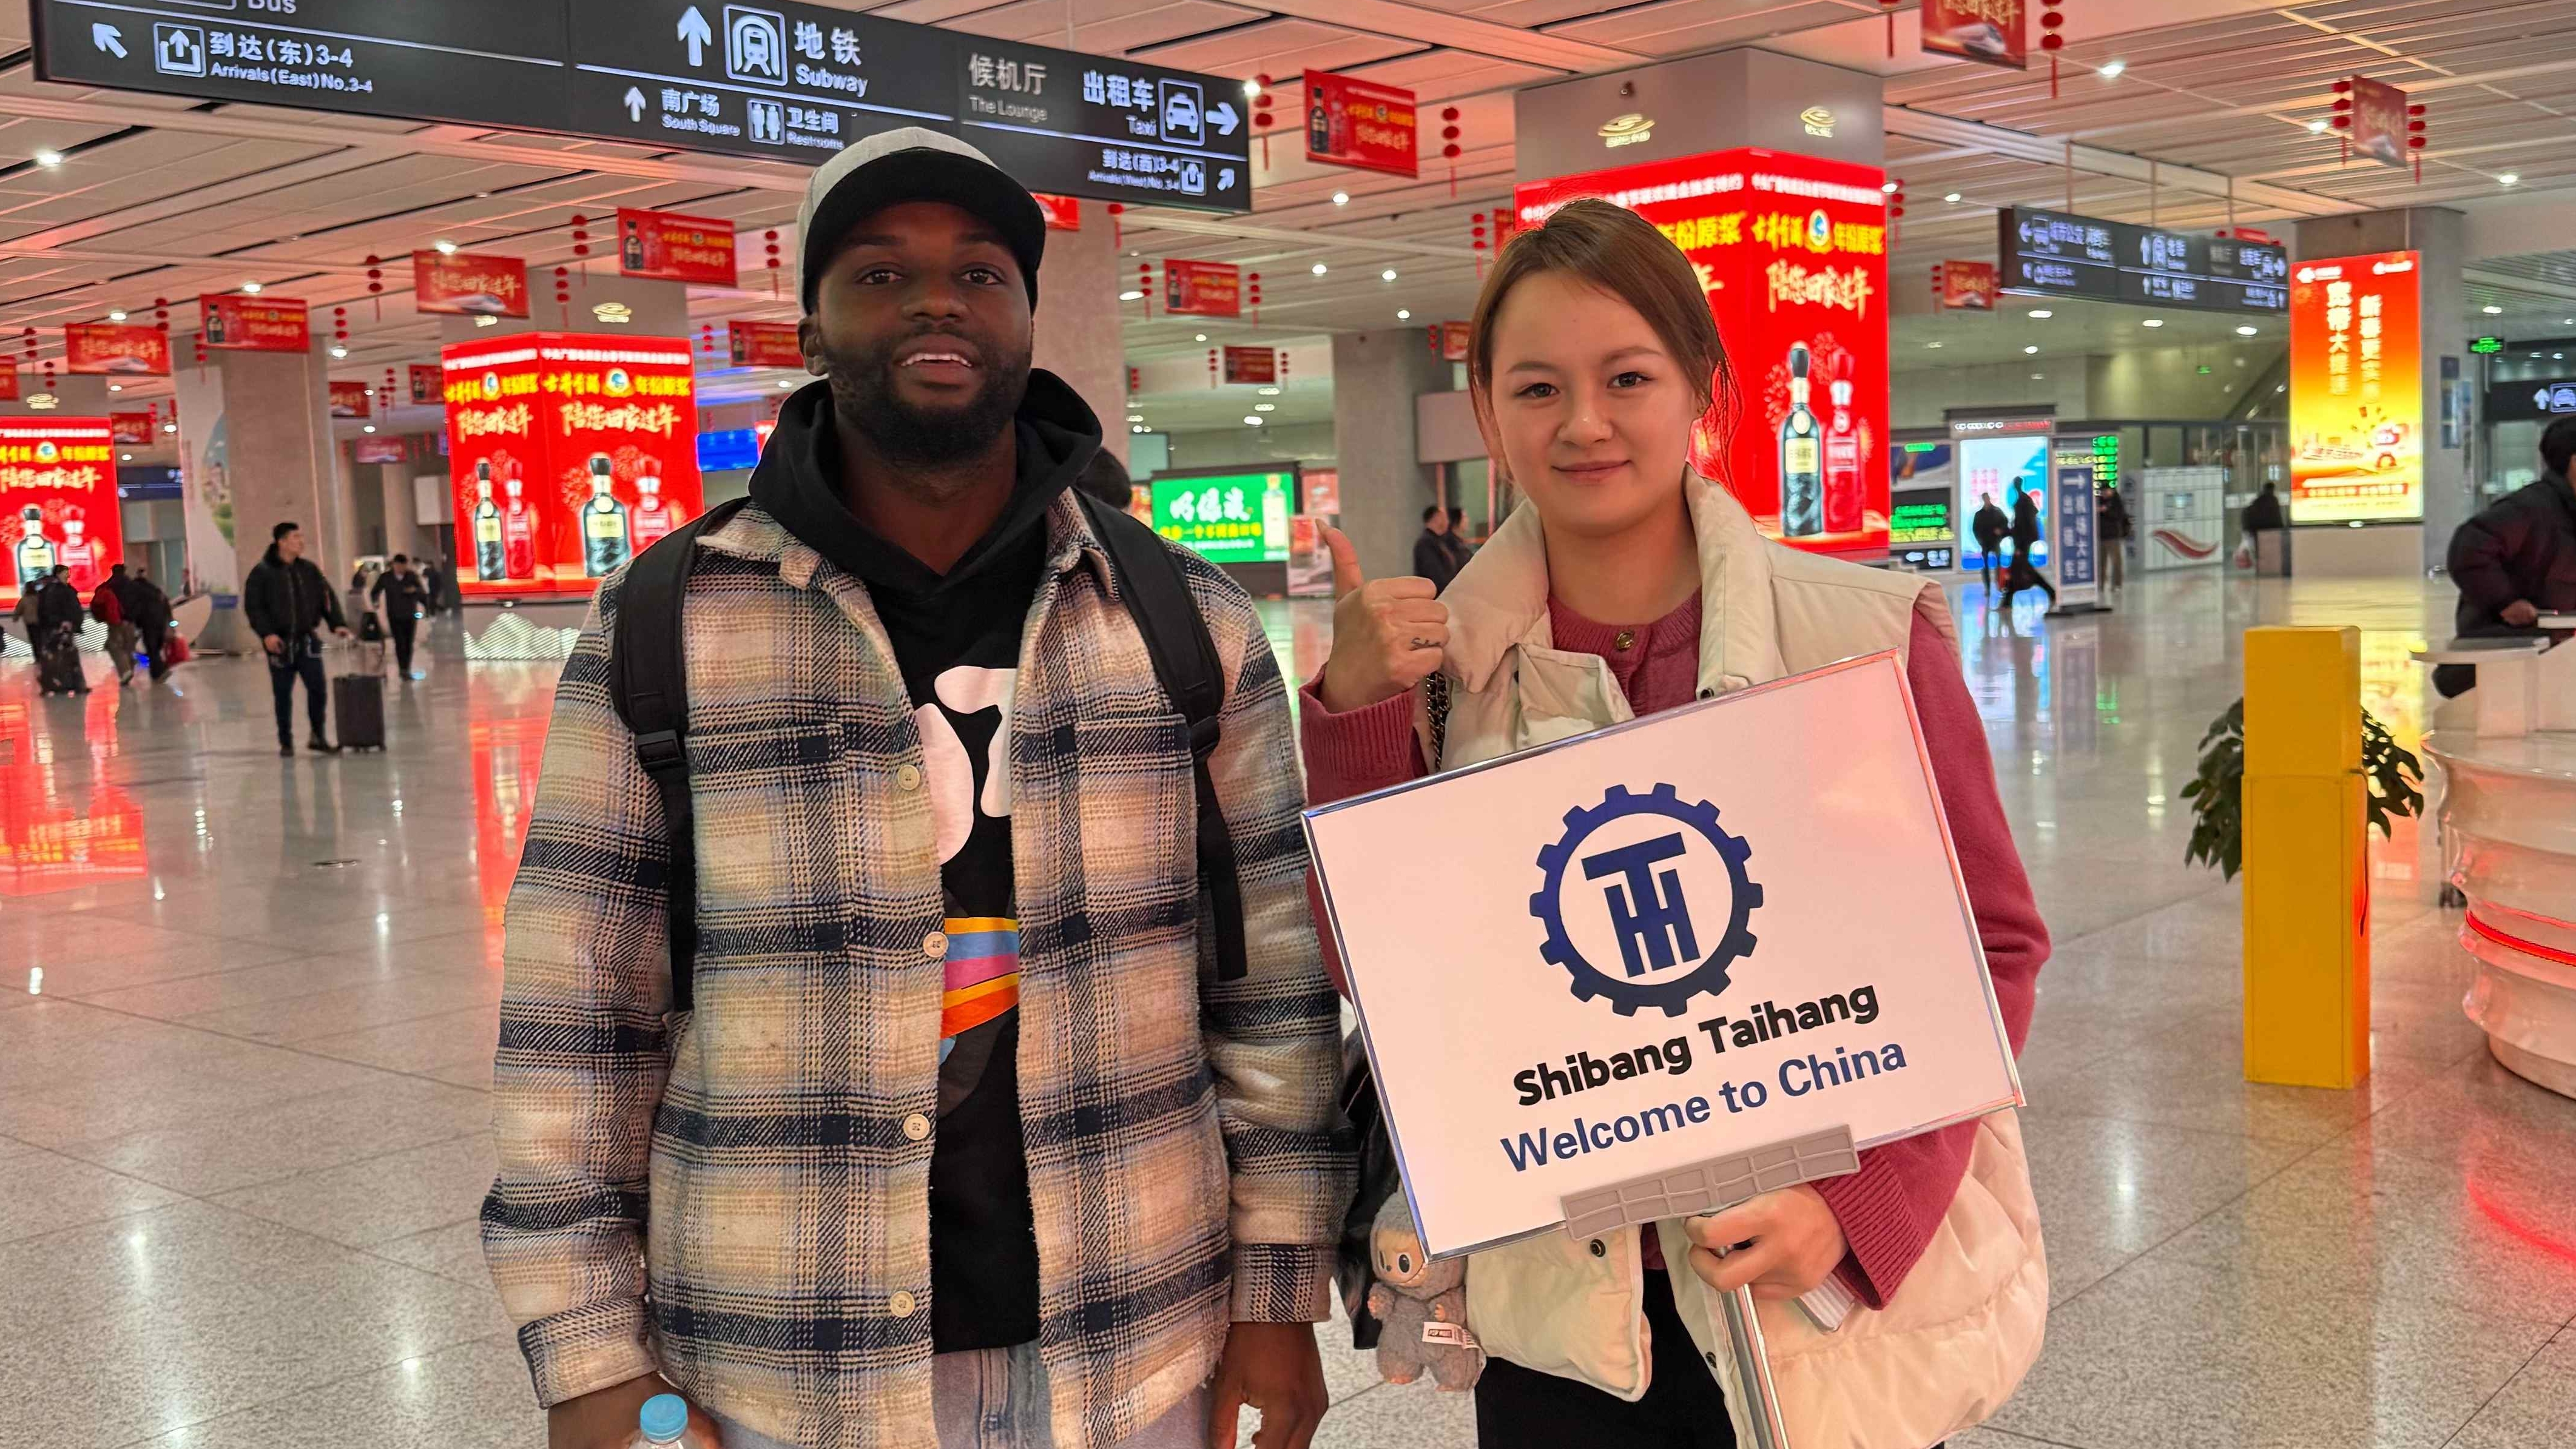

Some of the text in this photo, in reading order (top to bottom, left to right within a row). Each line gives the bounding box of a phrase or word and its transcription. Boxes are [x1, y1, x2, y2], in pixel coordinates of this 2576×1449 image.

[794, 19, 862, 66] 地铁
[795, 63, 868, 98] Subway
[969, 53, 1047, 95] 候机厅
[1083, 70, 1155, 112] 出租车
[661, 89, 720, 117] 南广场
[786, 107, 839, 134] 卫生间
[969, 95, 1048, 123] The Lounge
[1125, 115, 1157, 136] Taxi
[1513, 984, 1880, 1106] Shibang Taihang
[1500, 1041, 1907, 1172] Welcome to China
